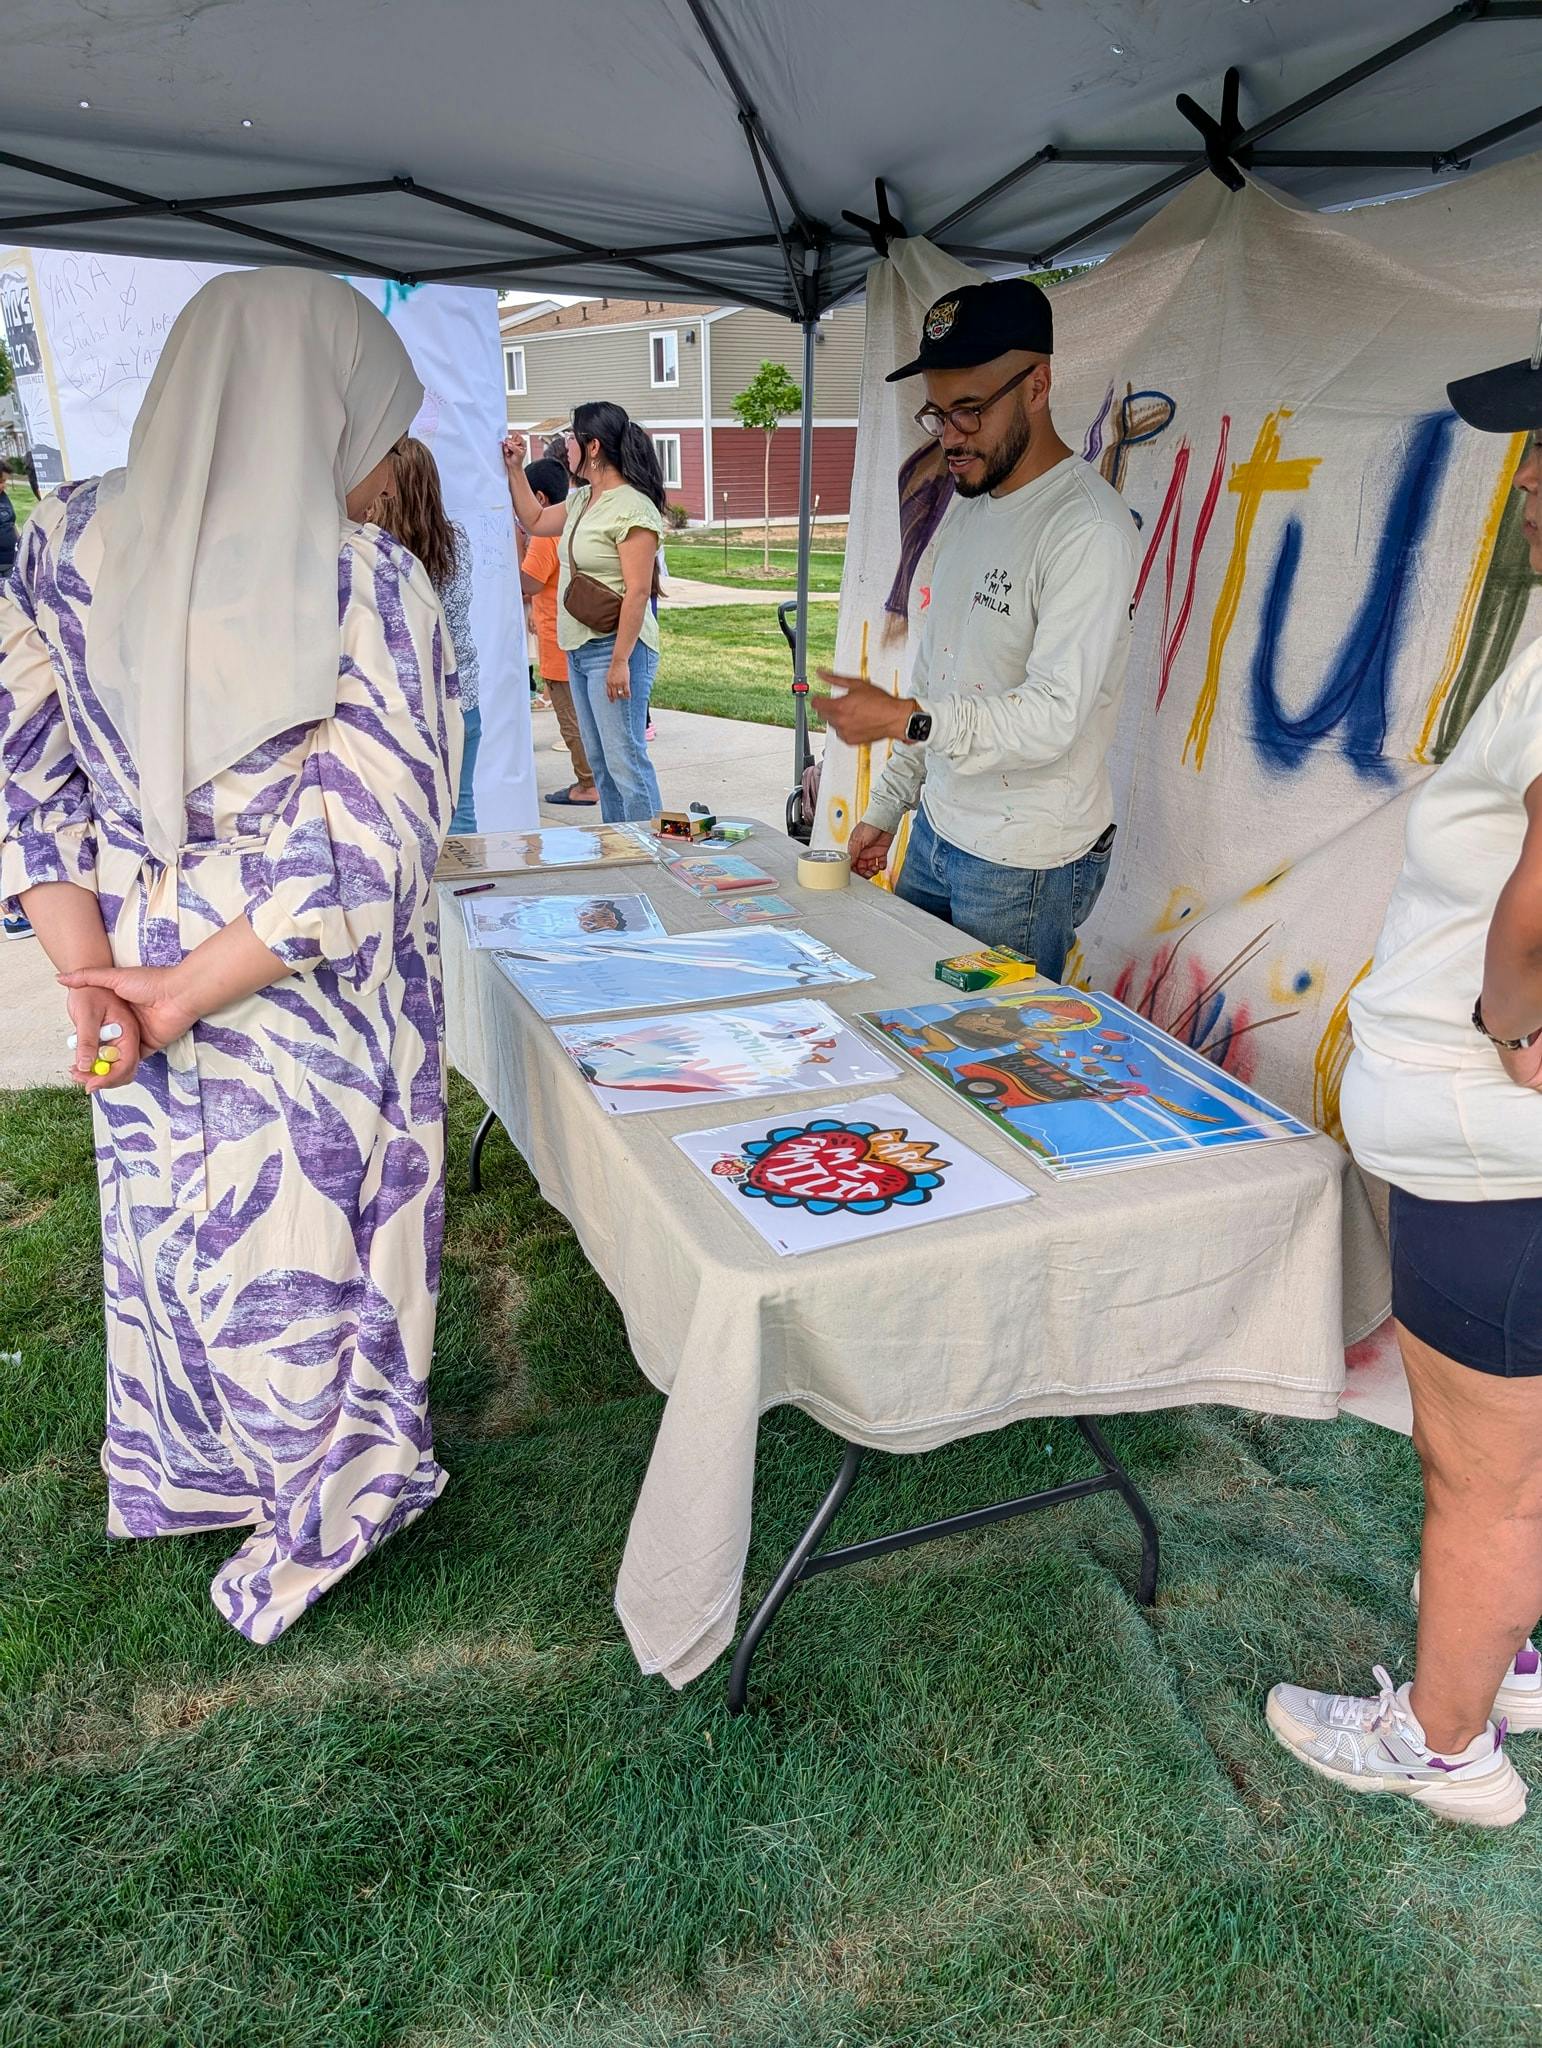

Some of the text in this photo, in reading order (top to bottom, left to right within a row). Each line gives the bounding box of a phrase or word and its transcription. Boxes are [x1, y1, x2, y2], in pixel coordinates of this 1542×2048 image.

[988, 580, 1000, 595] MI
[765, 1136, 880, 1200] FAMILIA
[822, 1147, 885, 1180] MI
[877, 1131, 932, 1173] PARA
